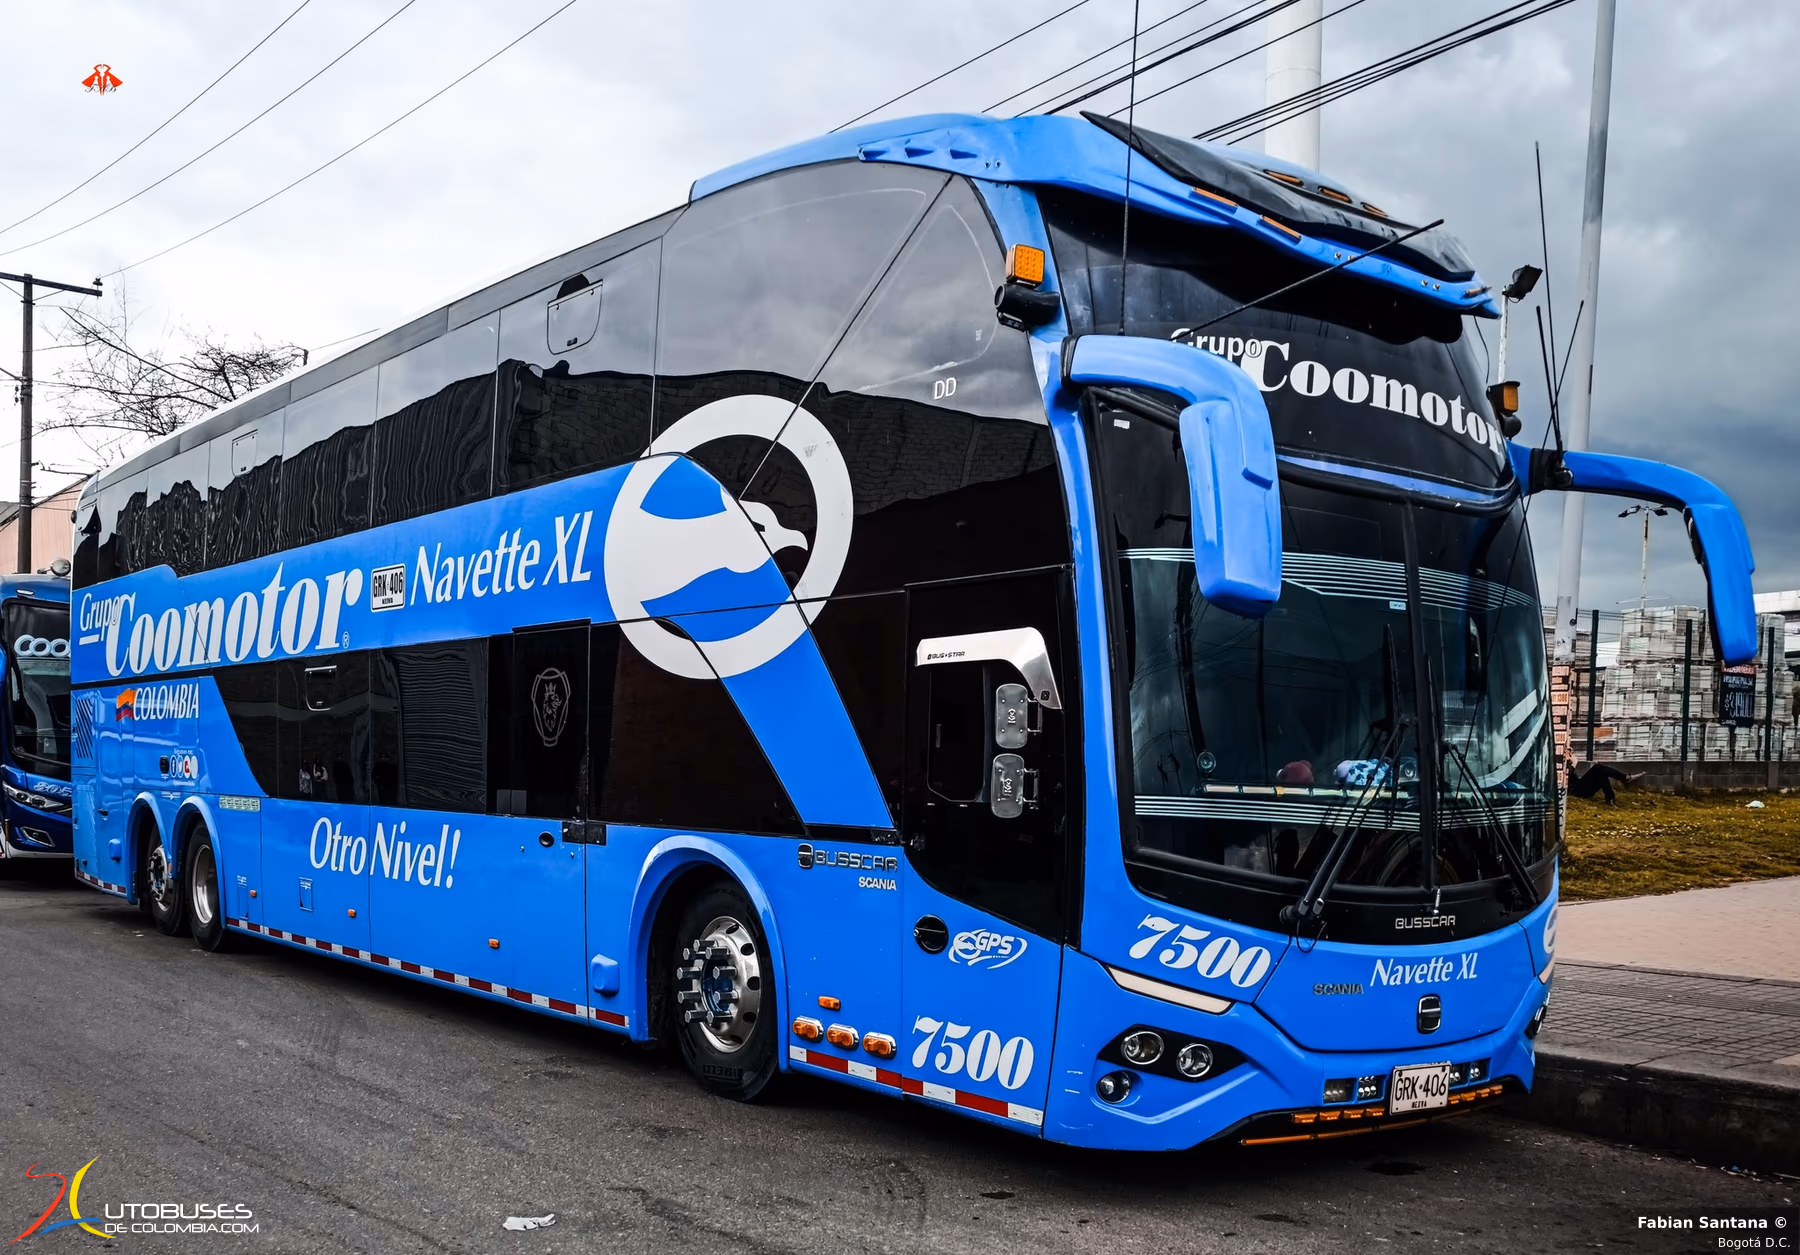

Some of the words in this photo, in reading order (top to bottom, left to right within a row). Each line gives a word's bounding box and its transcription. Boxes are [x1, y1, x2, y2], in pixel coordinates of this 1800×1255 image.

[934, 377, 957, 400] DD
[1241, 340, 1502, 455] Coomotor
[410, 526, 541, 606] Navette
[542, 510, 594, 586] XL
[79, 592, 120, 641] Grupo
[105, 561, 363, 677] Coomotor
[133, 682, 199, 721] COLOMBIA
[309, 817, 367, 876] Otro
[369, 820, 461, 889] Nivel!
[814, 850, 897, 872] BUSSCAR
[858, 876, 897, 890] SCANIA
[1395, 915, 1456, 929] BUSSCAR
[976, 931, 1015, 955] GPS
[1129, 914, 1271, 988] 7500
[1370, 956, 1453, 987] Navette
[1456, 952, 1478, 980] XL
[1313, 983, 1364, 996] SCANIA
[911, 1015, 1034, 1090] 7500
